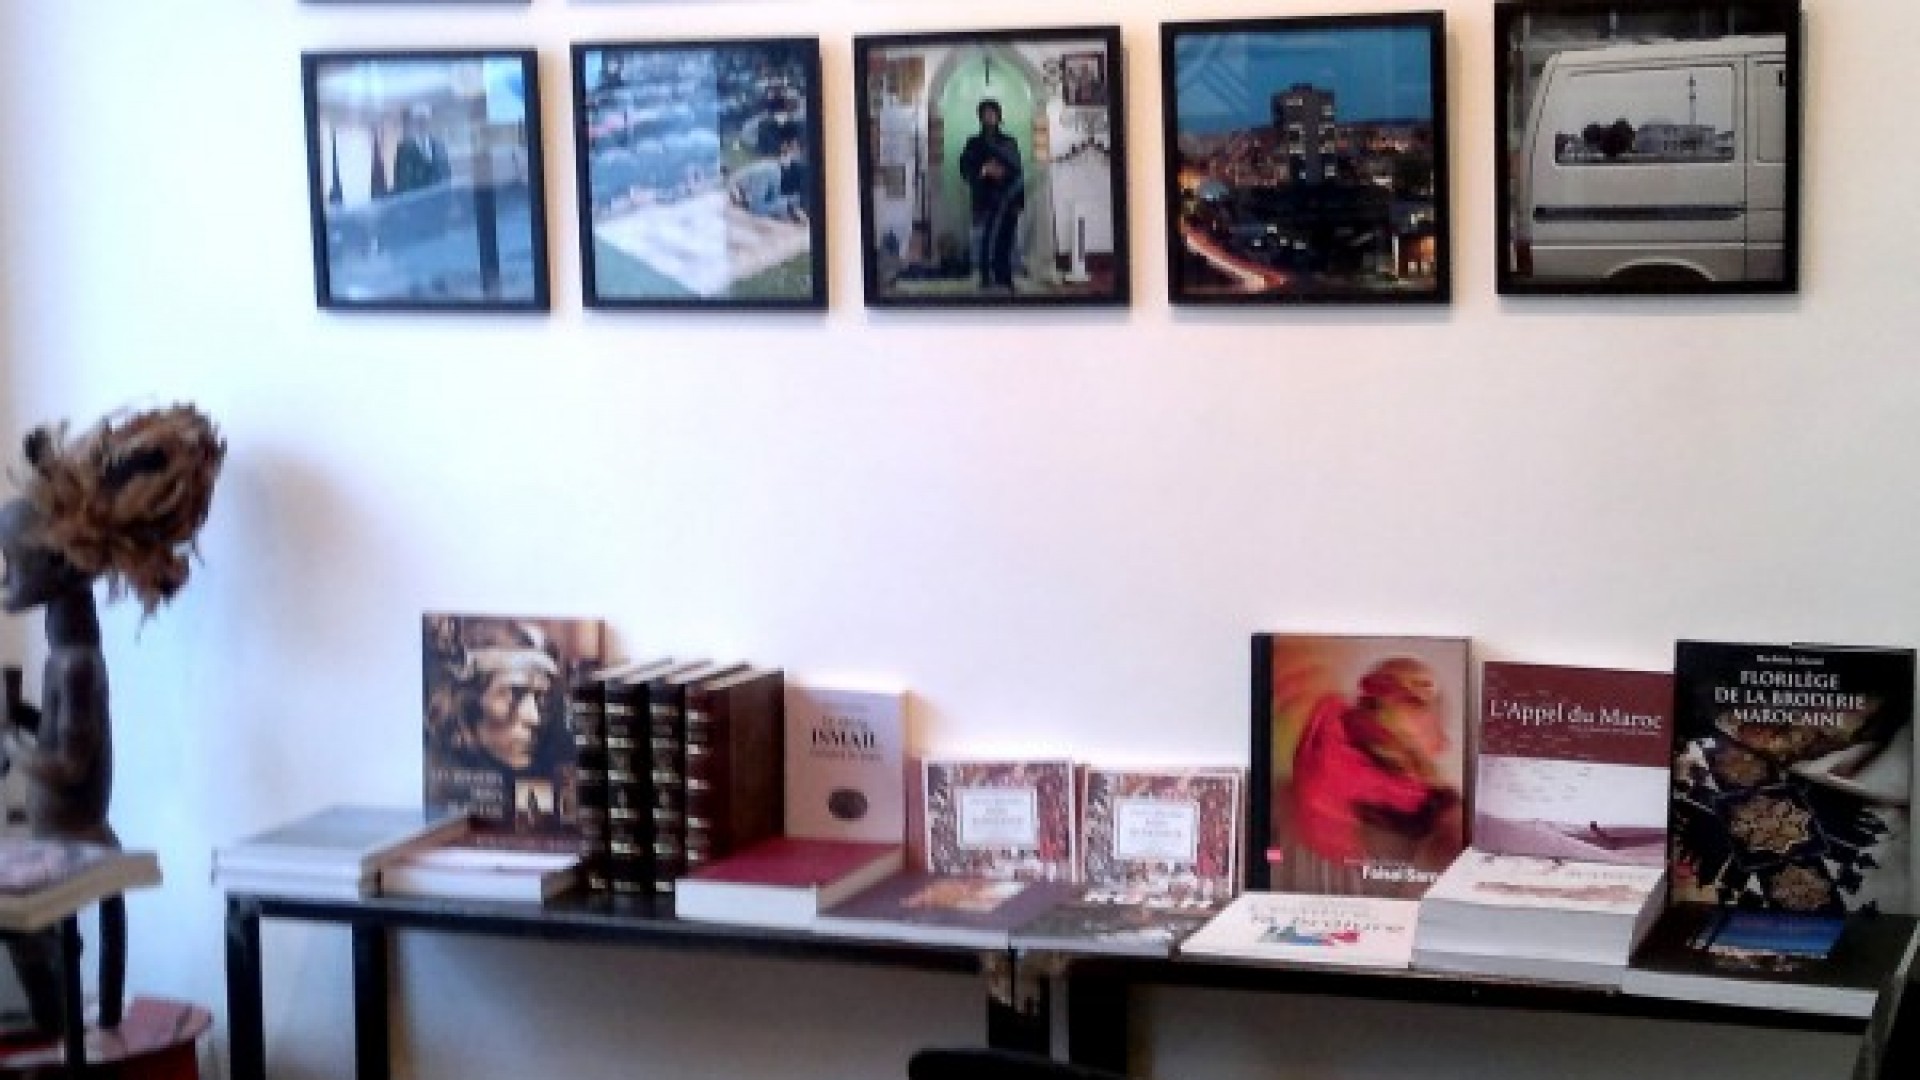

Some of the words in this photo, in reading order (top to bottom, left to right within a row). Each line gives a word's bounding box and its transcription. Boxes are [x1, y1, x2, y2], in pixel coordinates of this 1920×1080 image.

[1740, 669, 1841, 691] FLORILÈGE
[1714, 686, 1740, 704] DE
[1746, 688, 1768, 705] LA
[1772, 688, 1867, 711] BRODERIE
[1489, 699, 1564, 727] L'Appel
[1567, 704, 1595, 724] du
[1599, 708, 1663, 731] Maroc
[1733, 708, 1845, 729] MAROCAINE
